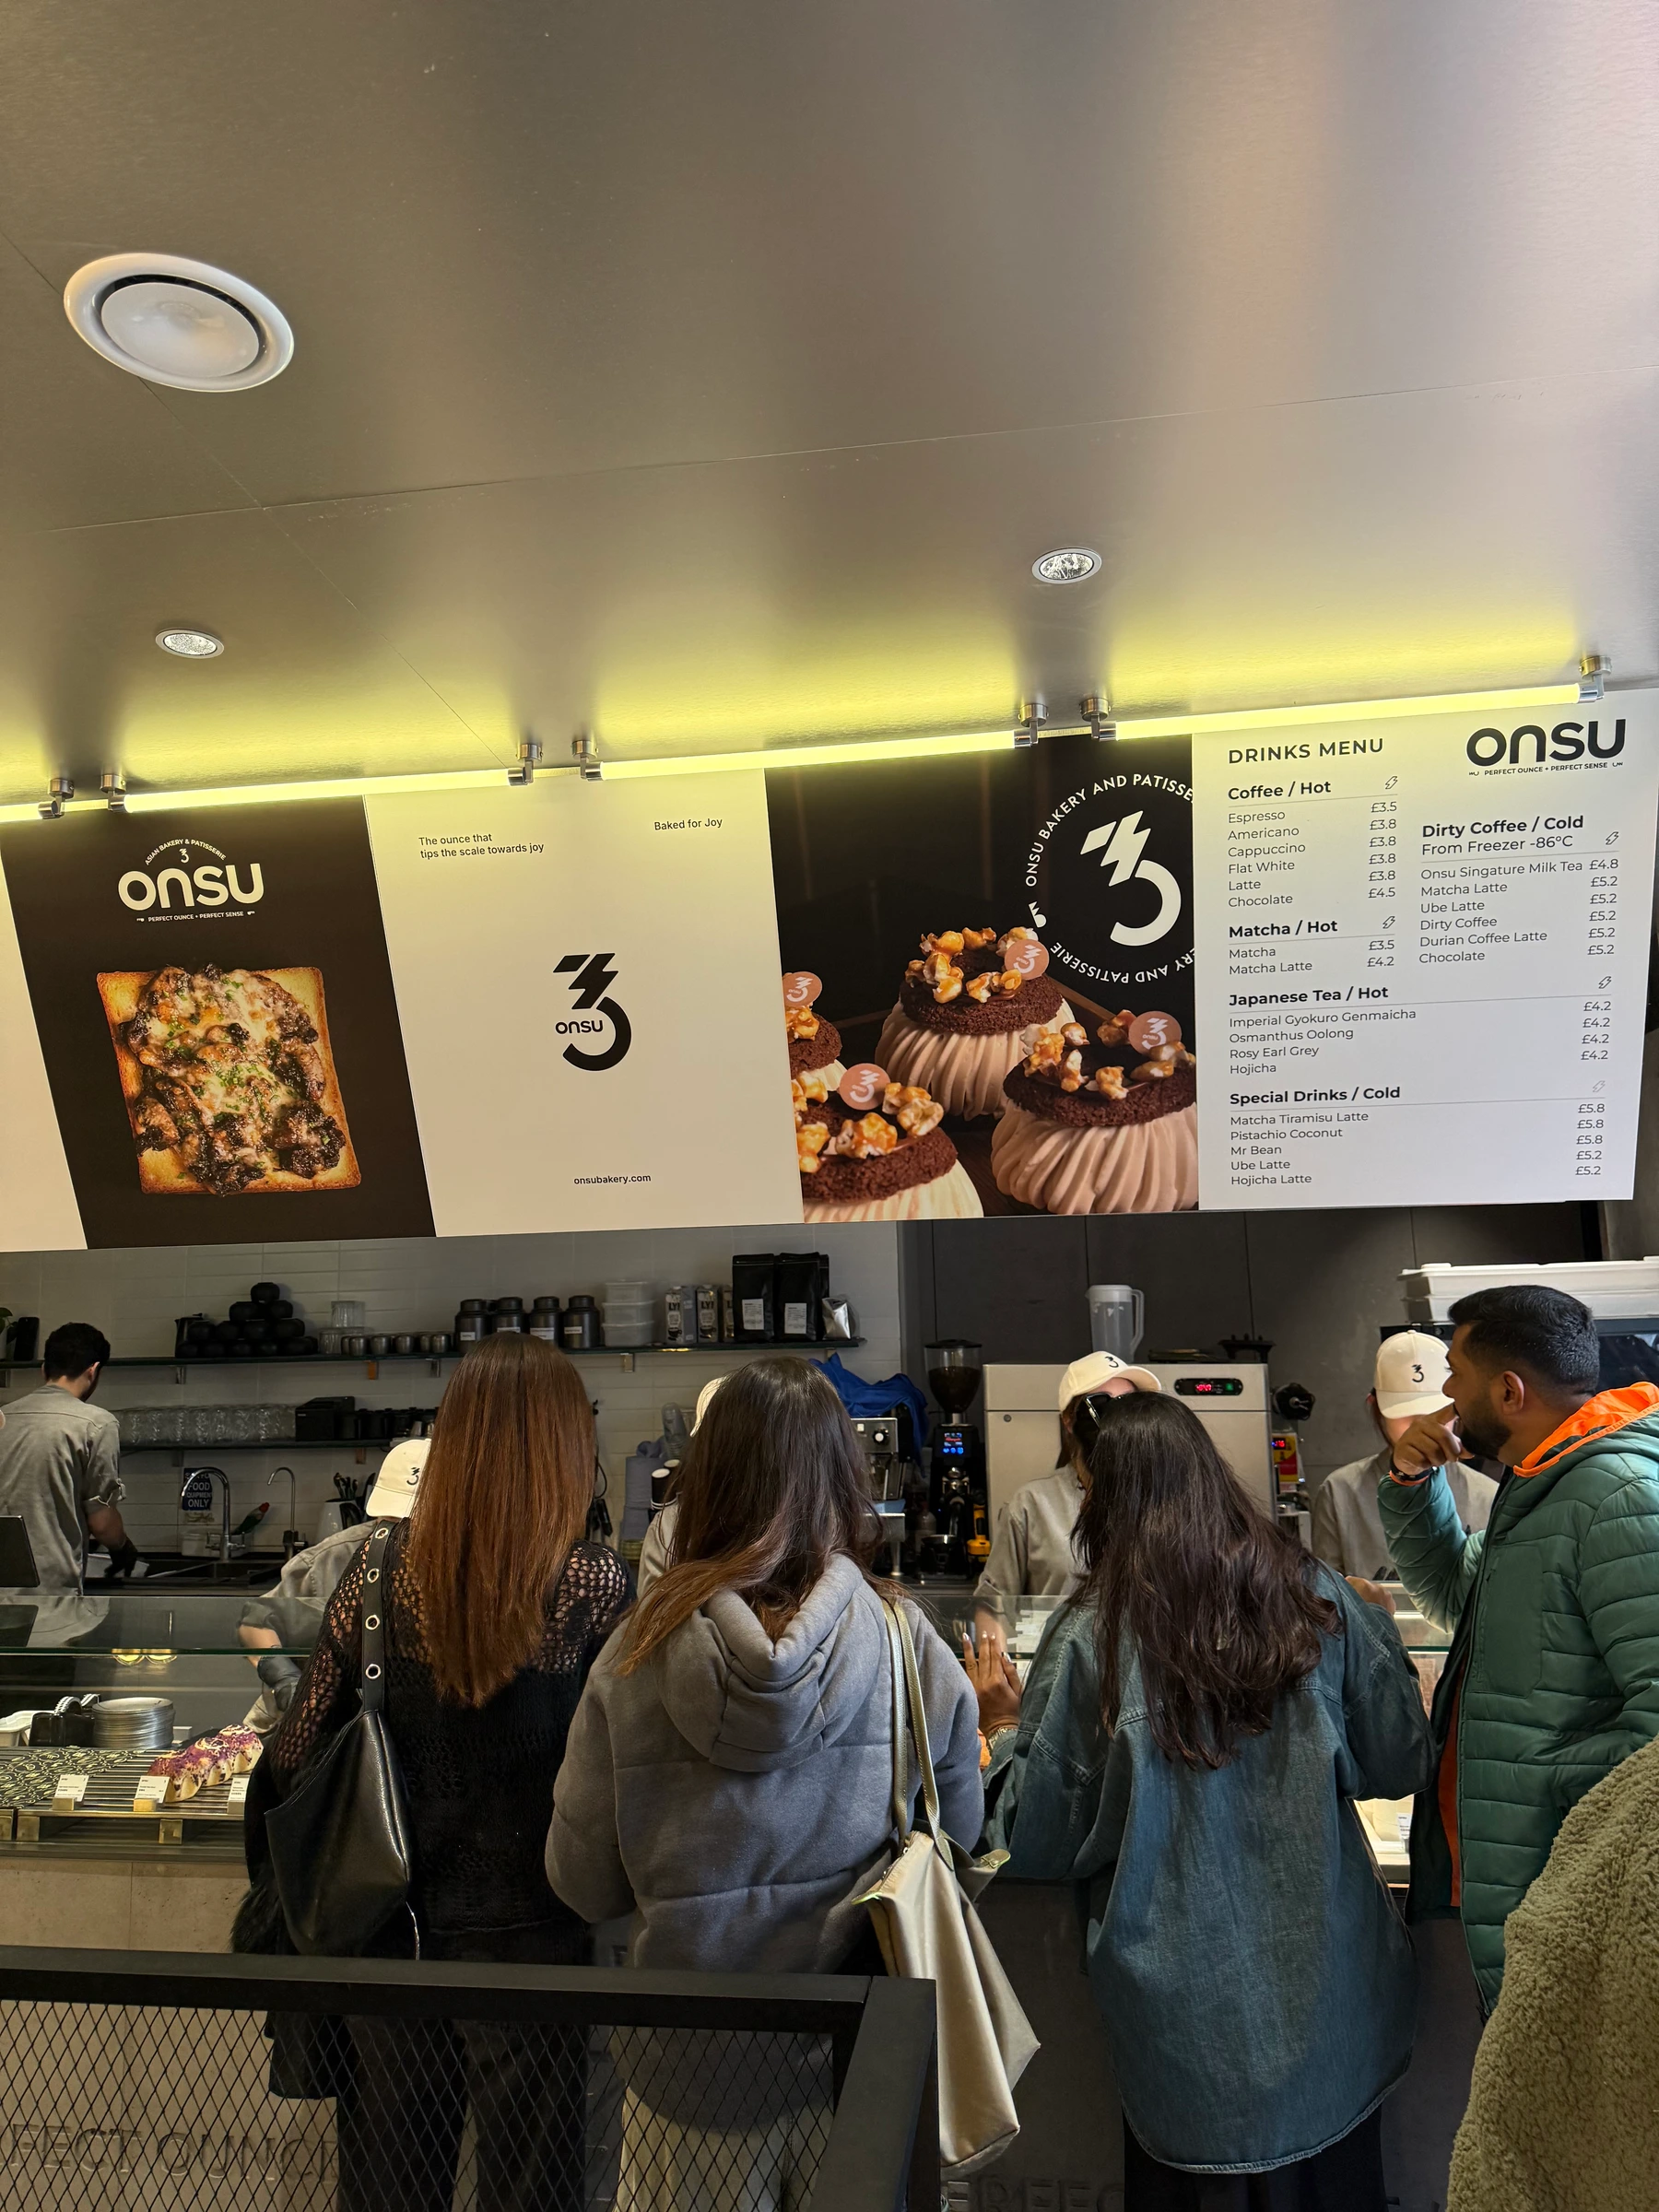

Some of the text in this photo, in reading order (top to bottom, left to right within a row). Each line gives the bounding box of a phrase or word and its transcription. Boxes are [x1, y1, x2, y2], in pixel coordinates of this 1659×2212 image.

[1230, 738, 1382, 764] DRINKS MENU
[1228, 781, 1331, 800] Coffee / Hot
[1371, 801, 1397, 813] £3.5
[654, 818, 723, 830] Baked for Joy
[1229, 812, 1285, 825] Espresso
[1370, 818, 1396, 830] £3.8
[1026, 773, 1194, 887] ONSU BAKERY AND PATISSE
[1423, 815, 1583, 839] Dirty Coffee / Cold
[418, 834, 492, 845] The ounce that
[1228, 828, 1300, 841] Americano
[1369, 836, 1396, 847] £3.8
[145, 848, 159, 865] ASIAN
[159, 839, 183, 851] BAKERY
[191, 839, 226, 860] PATISSERIE
[420, 843, 544, 860] tips the scale towards joy
[1228, 842, 1306, 858] Cappuccino
[1422, 843, 1462, 855] From
[1468, 841, 1525, 853] Freezer
[1369, 853, 1396, 865] £3.8
[1589, 858, 1618, 870] £4.8
[1229, 860, 1295, 874] Flat White
[1421, 861, 1583, 879] Onsu Singature Milk Tea
[1369, 870, 1395, 881] £3.8
[1591, 876, 1618, 887] £5.2
[1229, 881, 1261, 890] Latte
[1420, 883, 1508, 898] Matcha Latte
[1368, 887, 1395, 899] £4.5
[1590, 893, 1617, 904] £5.2
[1229, 895, 1293, 907] Chocolate
[1421, 901, 1485, 913] Ube Latte
[1589, 911, 1616, 922] £5.2
[1230, 920, 1337, 938] Matcha / Hot
[1420, 916, 1497, 931] Dirty Coffee
[1588, 927, 1615, 938] £5.2
[1369, 939, 1394, 950] £3.5
[1420, 932, 1547, 947] Durian Coffee Latte
[1230, 947, 1276, 959] Matcha
[1587, 944, 1614, 955] £5.2
[1050, 942, 1129, 983] PATISSERIE
[1367, 956, 1394, 967] £4.2
[1419, 951, 1485, 963] Chocolate
[1135, 965, 1168, 982] AND
[1230, 962, 1312, 975] Matcha Latte
[1229, 986, 1388, 1007] Japanese Tea / Hot
[1583, 1001, 1611, 1011] £4.2
[1230, 1009, 1416, 1029] Imperial Gyokuro Genmaicha
[1583, 1018, 1610, 1028] £4.2
[1230, 1029, 1353, 1043] Osmanthus Oolong
[1582, 1034, 1609, 1044] £4.2
[1230, 1046, 1319, 1060] Rosy Earl Grey
[1581, 1050, 1608, 1060] £4.2
[1230, 1064, 1277, 1076] Hojicha
[1230, 1087, 1400, 1107] Special Drinks / Cold
[1578, 1103, 1605, 1113] £5.8
[1230, 1112, 1369, 1125] Matcha Tiramisu Latte
[1577, 1119, 1604, 1129] £5.8
[1230, 1129, 1343, 1140] Pistachio Coconut
[1576, 1135, 1603, 1145] £5.8
[1231, 1146, 1282, 1155] Mr Bean
[1576, 1150, 1602, 1160] £5.2
[1231, 1160, 1290, 1171] Ube Latte
[1575, 1166, 1601, 1175] £5.2
[574, 1175, 651, 1184] onsubakery.com
[1231, 1175, 1312, 1187] Hojicha Latte
[187, 1499, 209, 1508] ONLY
[0, 2123, 141, 2172] FECT
